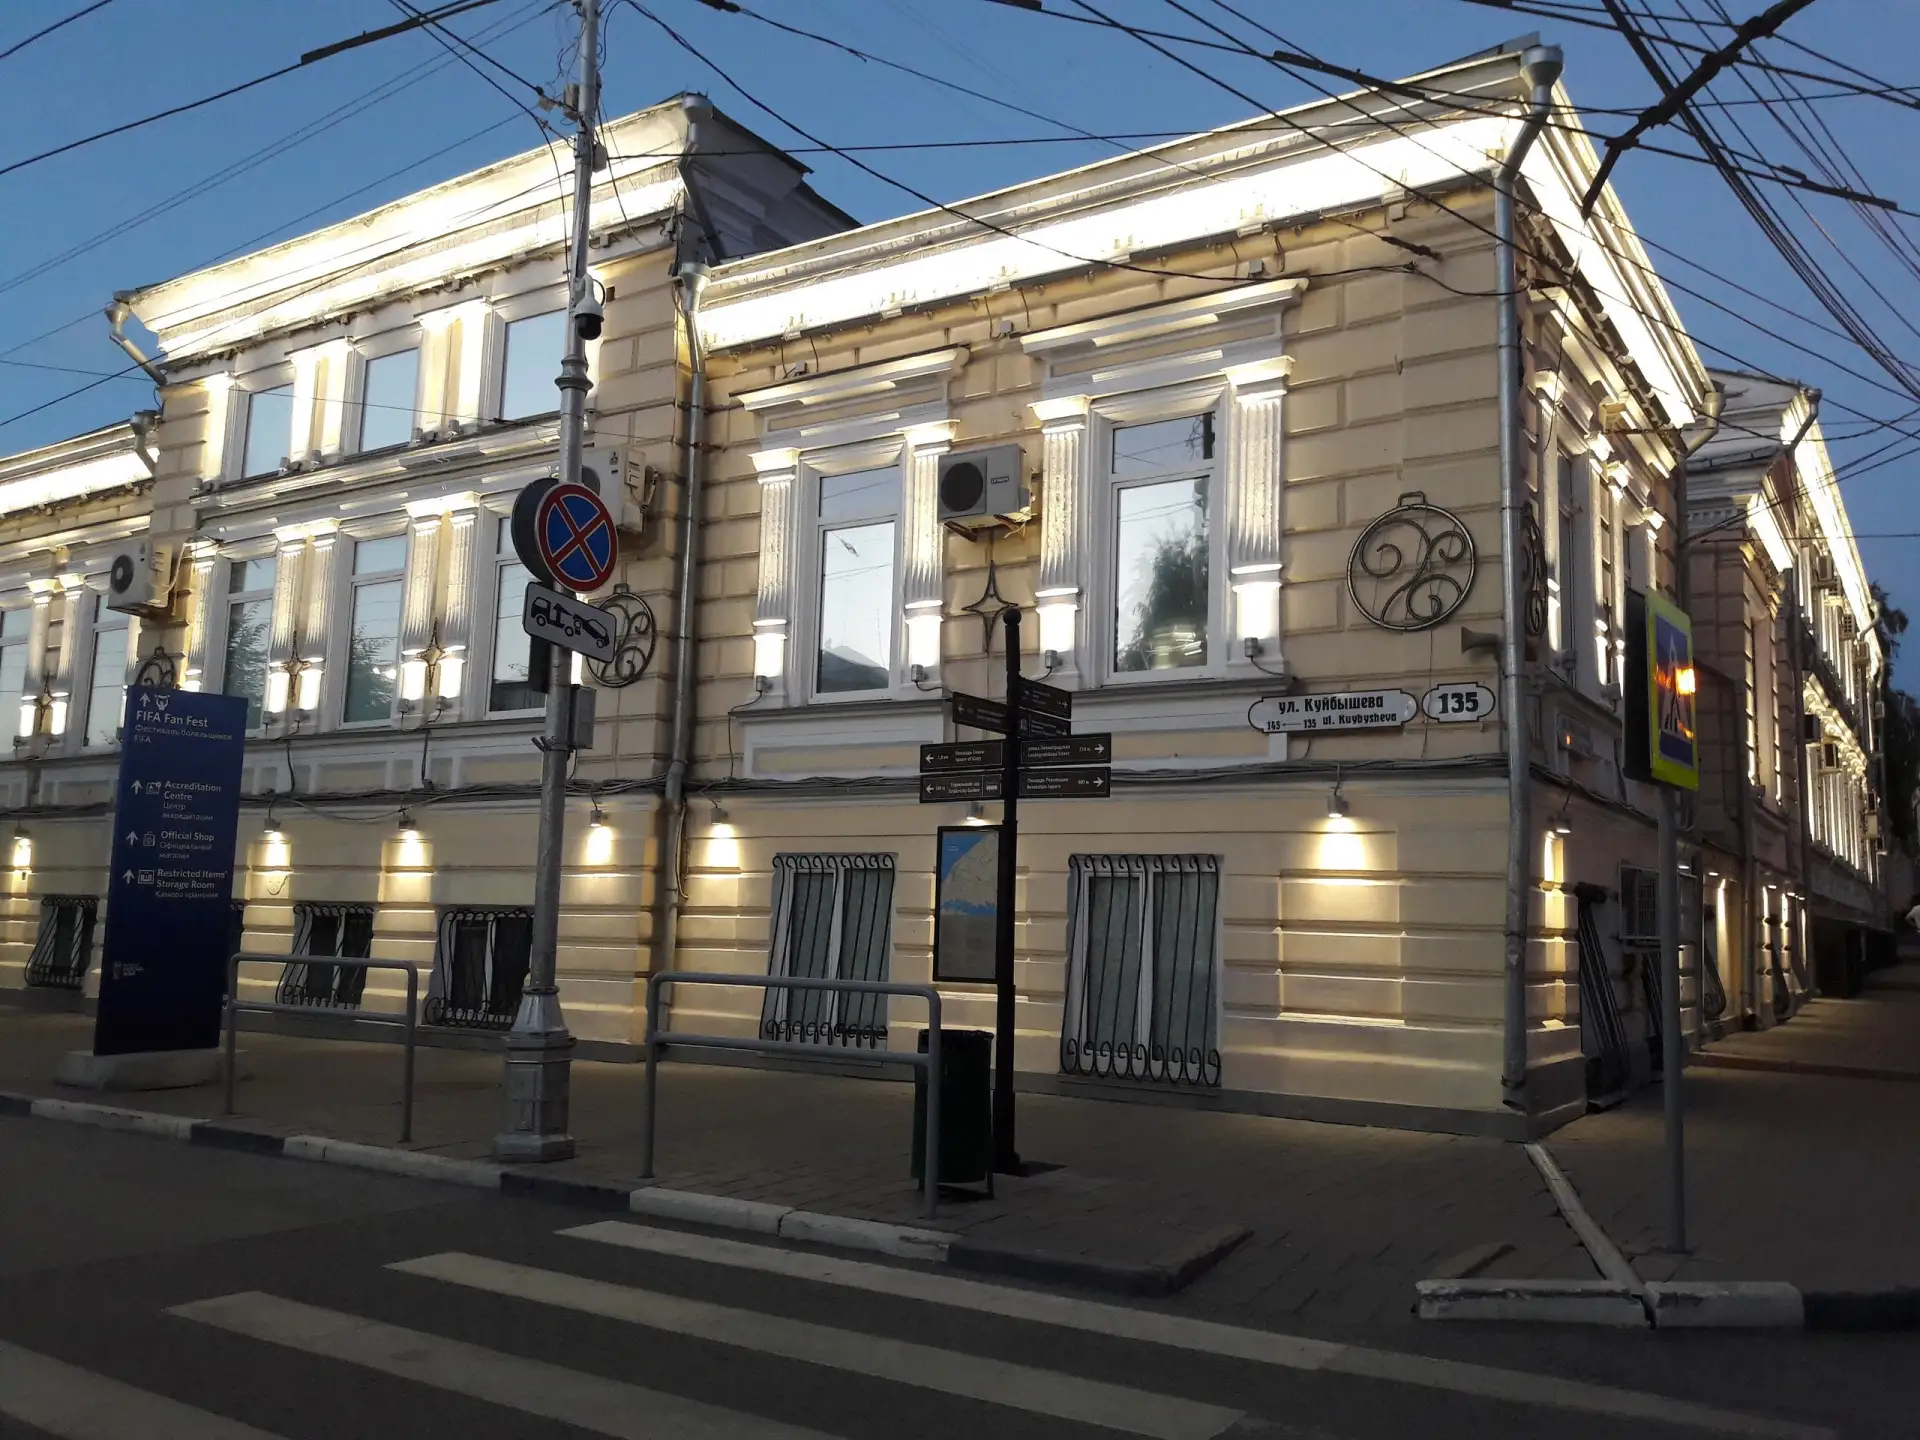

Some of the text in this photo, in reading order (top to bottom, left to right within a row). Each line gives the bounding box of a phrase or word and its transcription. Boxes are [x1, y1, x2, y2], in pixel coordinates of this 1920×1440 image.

[1279, 696, 1384, 714] ул. Куйбышева
[1438, 692, 1479, 714] 135
[136, 710, 208, 728] FIFA Fan Fest
[1304, 718, 1317, 729] 135
[1323, 715, 1335, 725] ul.
[1339, 712, 1397, 725] Kuybysheva
[134, 724, 180, 736] Фестиваль
[134, 734, 152, 744] FIFA
[165, 780, 222, 793] Accreditation
[164, 790, 193, 801] Centre
[160, 830, 215, 843] Official Shop
[157, 868, 201, 878] Restricted
[156, 879, 215, 890] Storage Room
